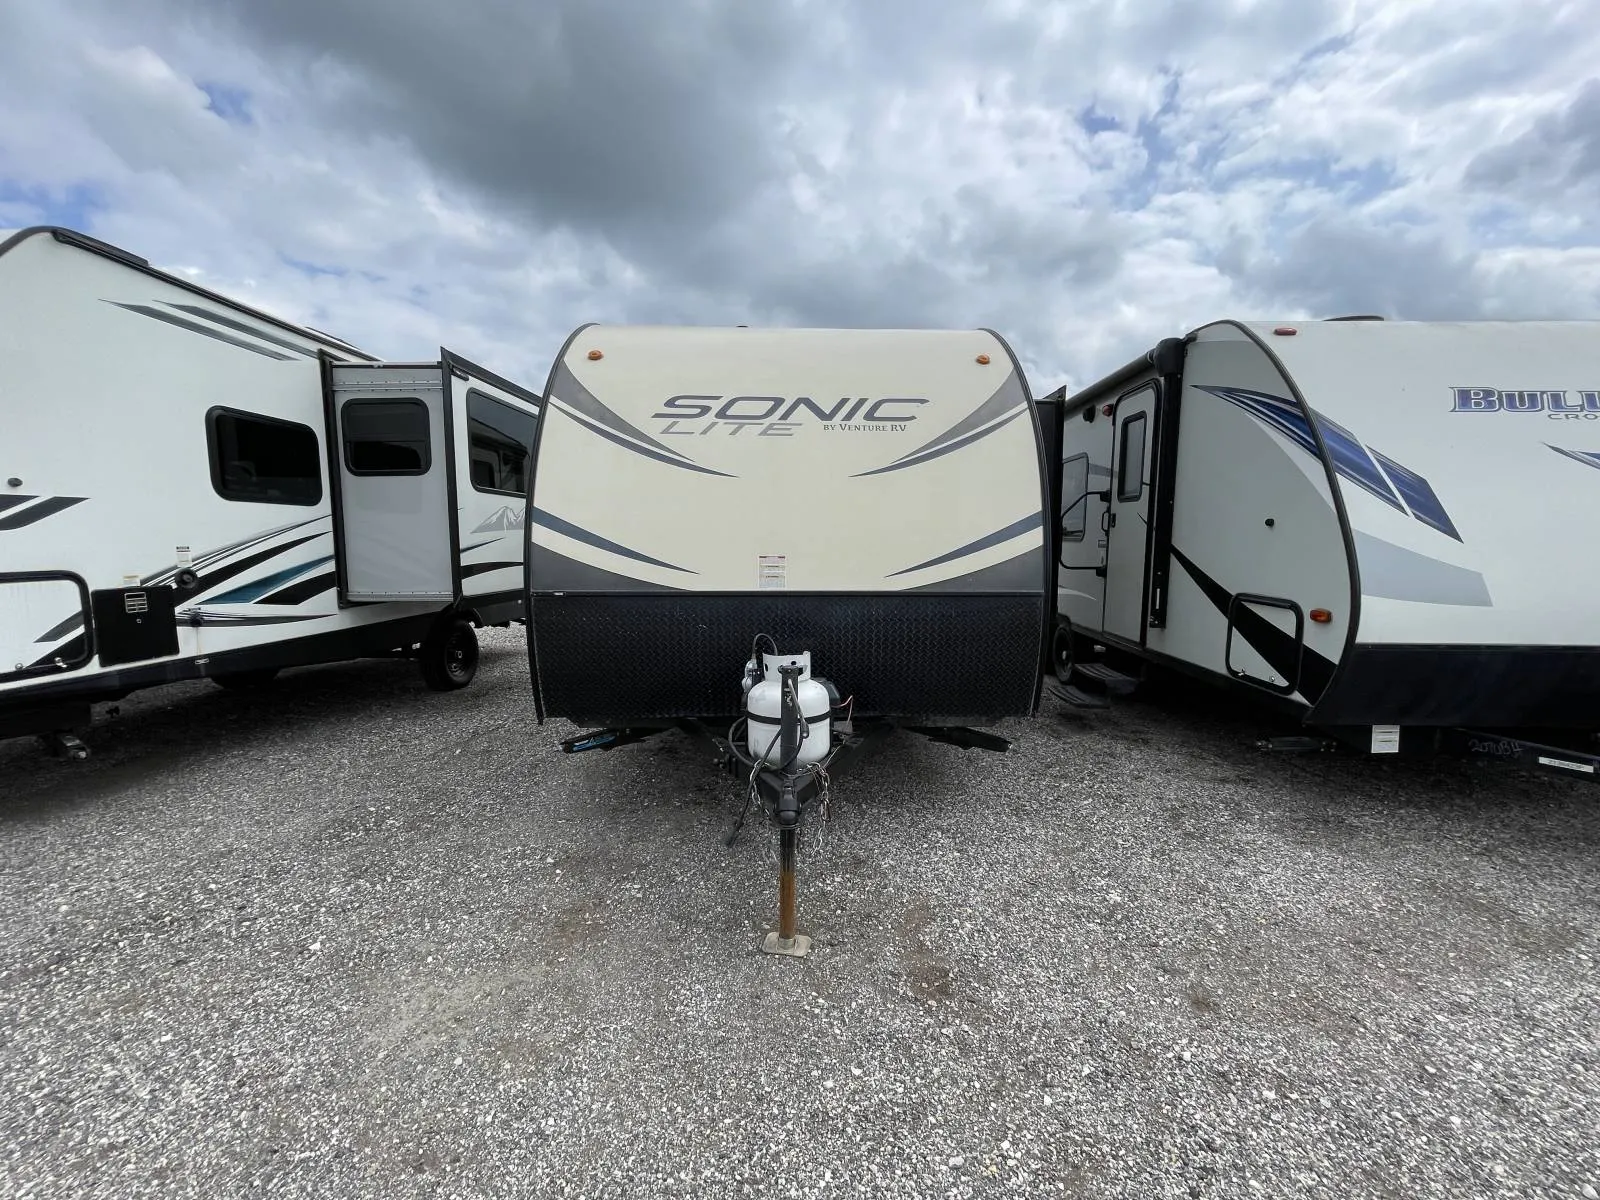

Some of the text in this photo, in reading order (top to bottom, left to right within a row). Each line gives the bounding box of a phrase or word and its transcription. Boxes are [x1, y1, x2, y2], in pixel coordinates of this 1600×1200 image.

[651, 394, 930, 422] SONIC
[659, 420, 803, 436] LITE
[823, 423, 907, 432] BY VENTURE RV
